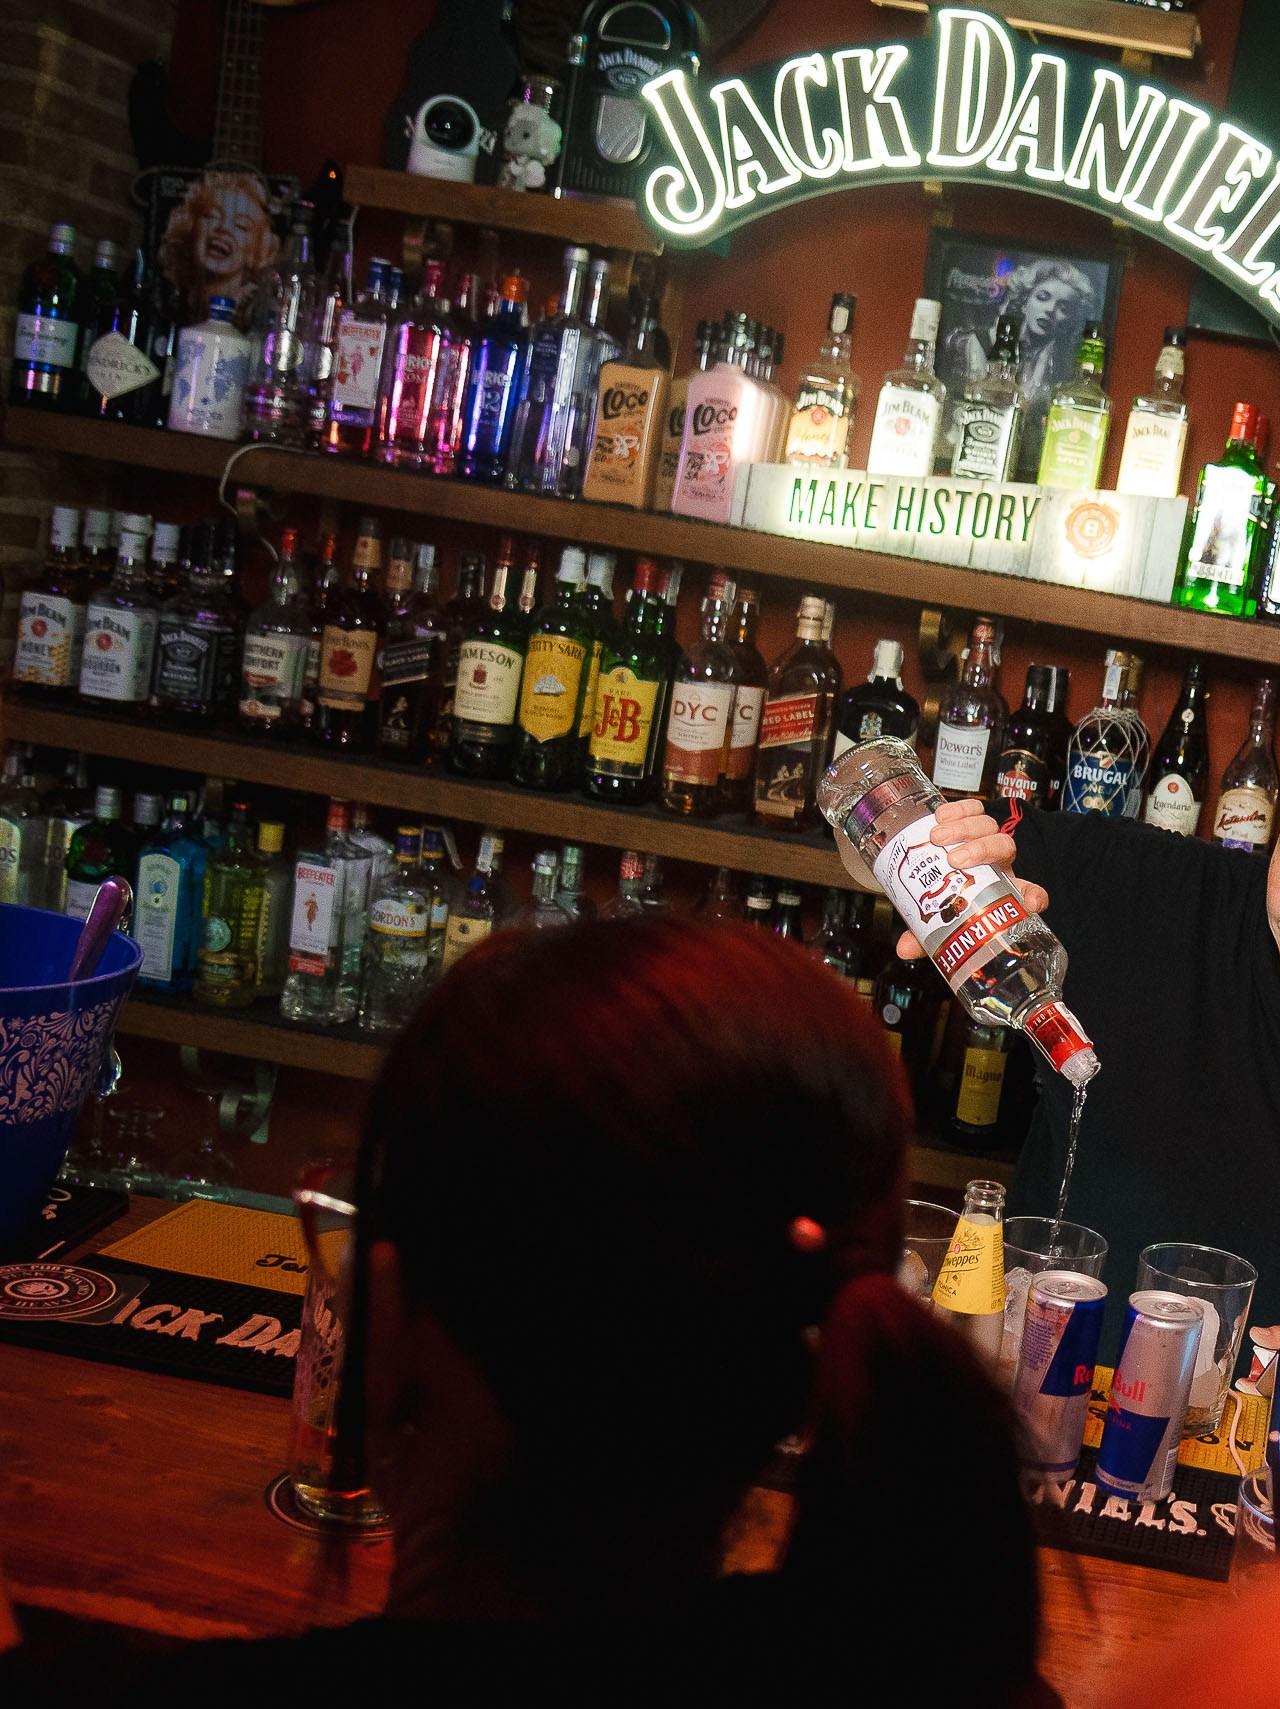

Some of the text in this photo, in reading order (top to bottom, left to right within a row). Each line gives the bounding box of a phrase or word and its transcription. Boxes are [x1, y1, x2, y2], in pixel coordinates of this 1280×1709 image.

[643, 46, 917, 235] JACK
[883, 400, 930, 424] JIM BEAM
[789, 477, 1044, 543] MAKE HISTORY
[595, 694, 642, 744] J&B
[673, 700, 719, 722] DYC
[782, 709, 815, 723] LABEL
[939, 737, 984, 757] Dewar's
[997, 772, 1038, 791] Havana
[1073, 764, 1128, 785] BRUGAL
[1001, 785, 1027, 800] Club
[296, 866, 336, 885] BEEFEATER
[908, 853, 941, 881] VODKA
[1072, 1364, 1094, 1386] Re
[1112, 1369, 1147, 1404] Bull
